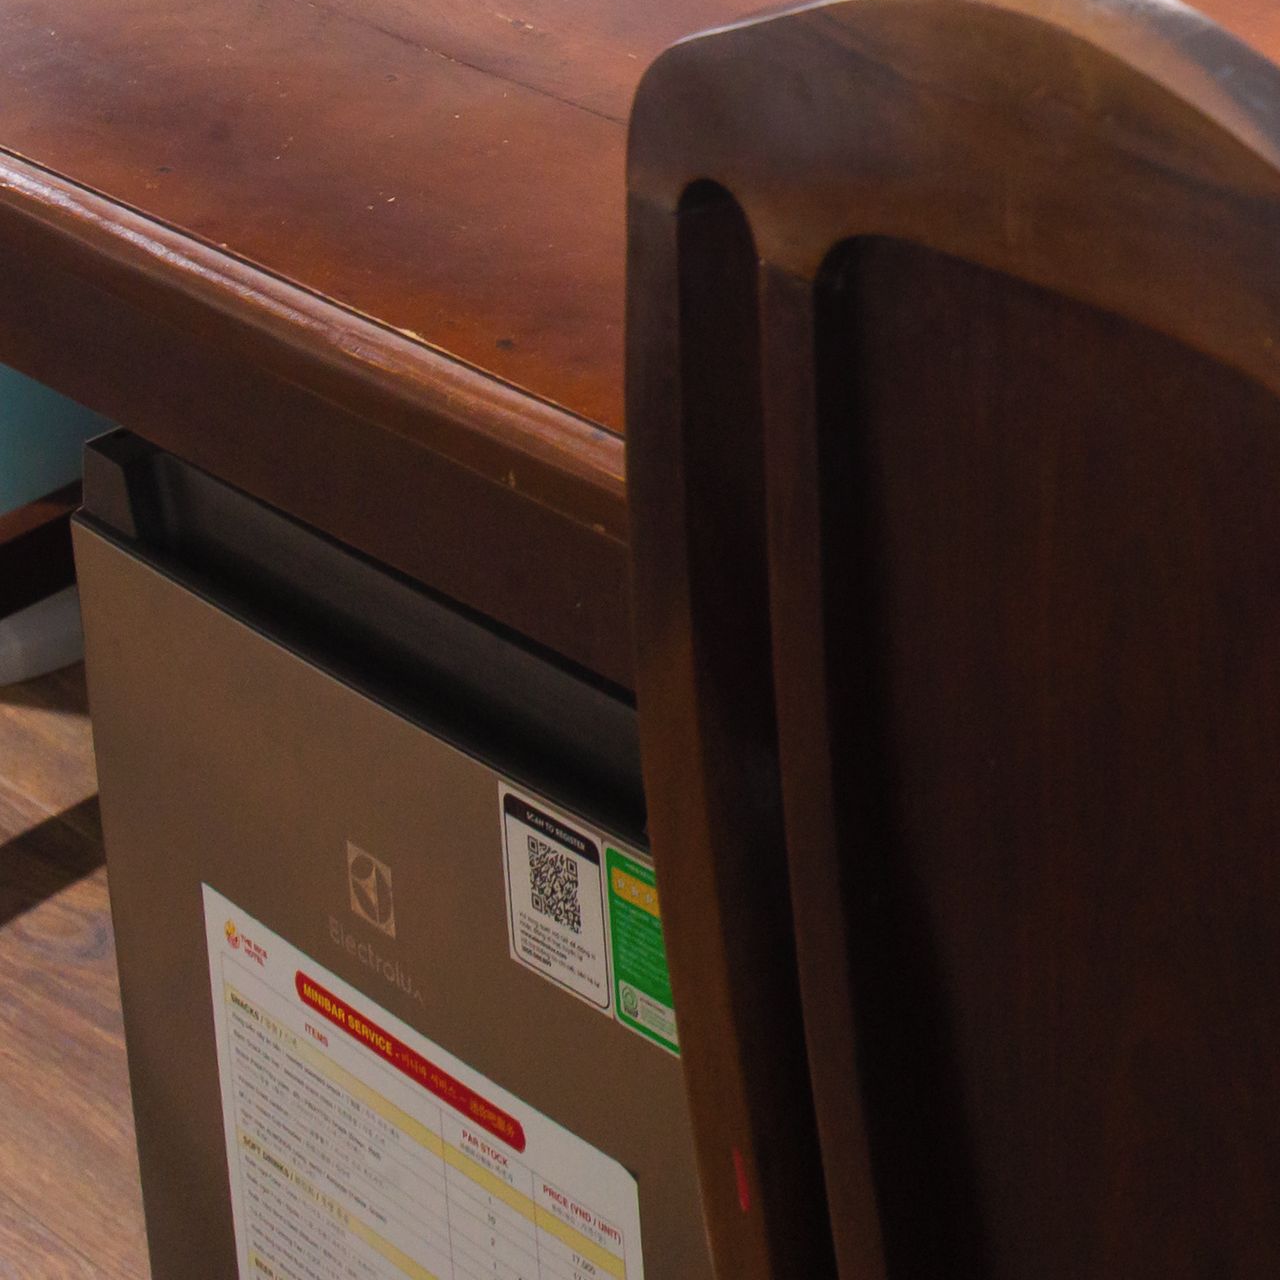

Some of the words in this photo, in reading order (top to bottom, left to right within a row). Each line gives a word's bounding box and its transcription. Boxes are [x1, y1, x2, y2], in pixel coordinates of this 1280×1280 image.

[303, 983, 346, 1023] MINIBAR
[347, 1014, 393, 1055] SERVICE
[304, 1022, 329, 1048] ITEMS
[462, 1129, 479, 1147] PAR
[480, 1142, 508, 1166] STOCK
[542, 1184, 568, 1208] PRICE
[569, 1201, 592, 1223] (VND
[598, 1220, 622, 1245] UNIT)
